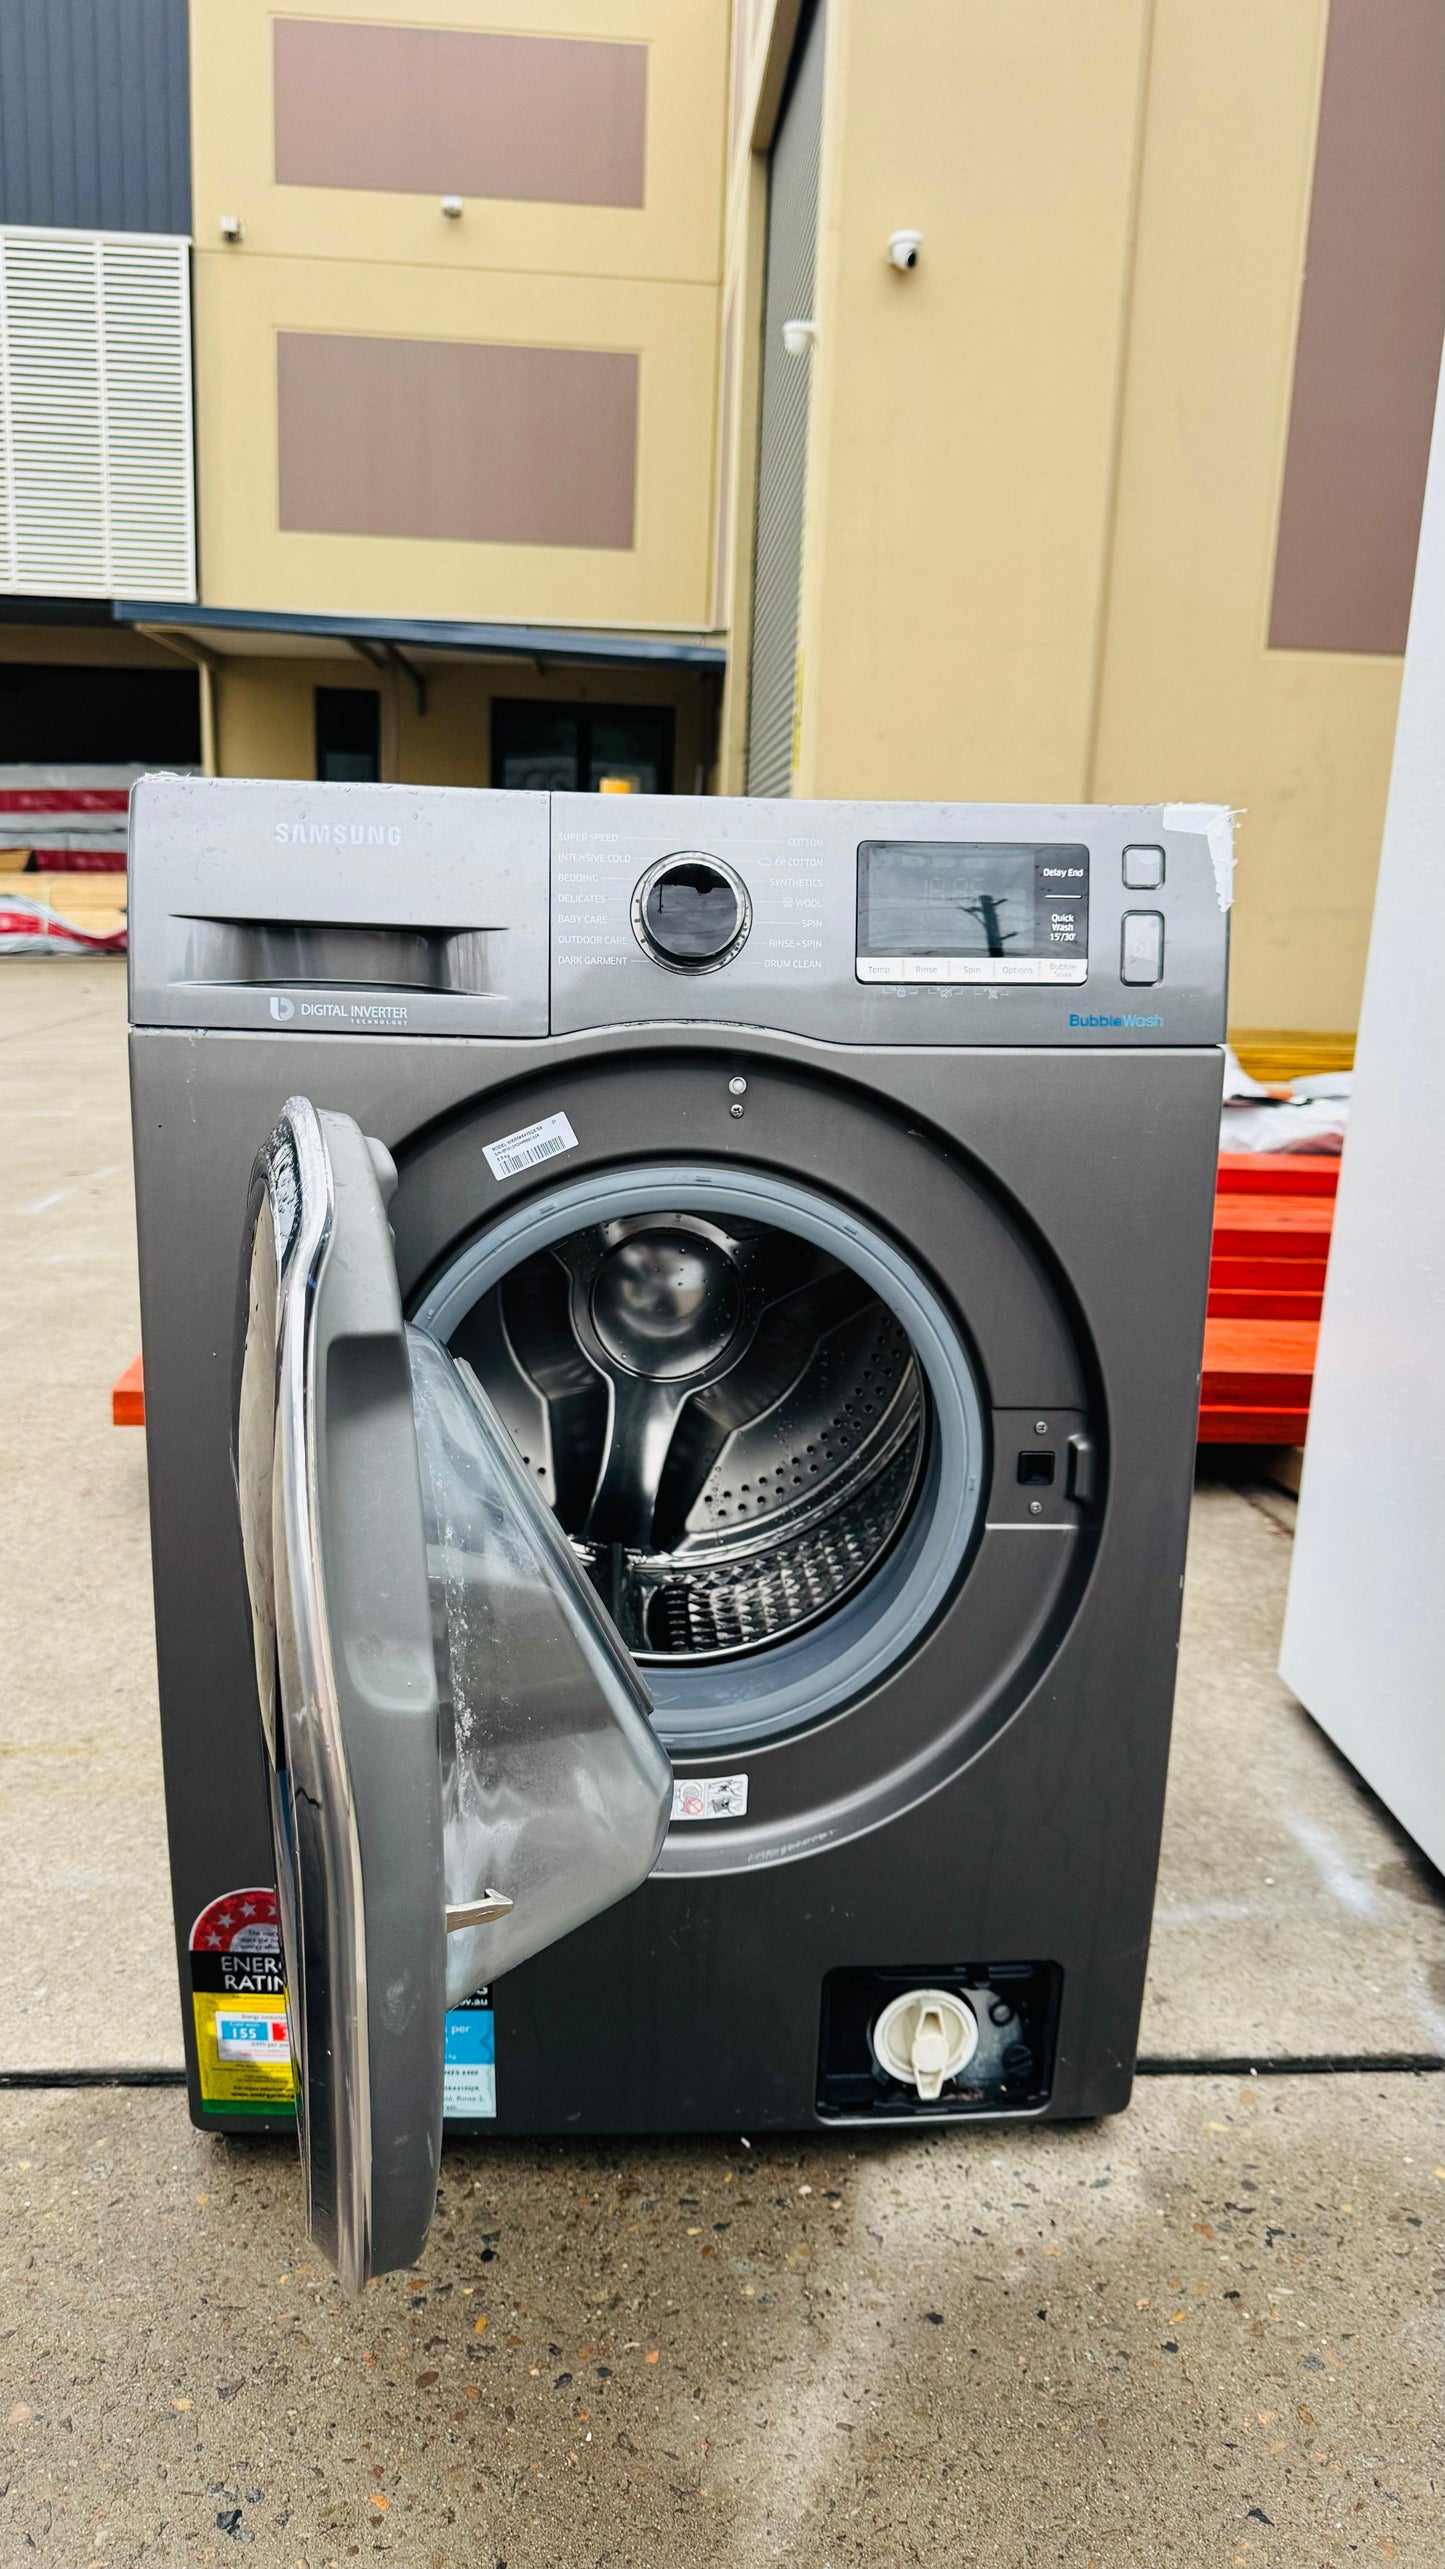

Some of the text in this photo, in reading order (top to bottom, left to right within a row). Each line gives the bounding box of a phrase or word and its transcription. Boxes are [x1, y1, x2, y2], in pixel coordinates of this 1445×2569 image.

[275, 823, 402, 846] SAMSUNG
[558, 832, 619, 842] SUPER SPEED
[787, 838, 824, 848] COTTON
[558, 853, 632, 863] INTENSIVE COLD
[787, 857, 824, 868] COTTON
[558, 873, 599, 883] BEDDING
[1043, 868, 1084, 878] Delay End
[769, 877, 824, 888] SYNTHETICS
[558, 893, 606, 904] DELICATES
[795, 898, 823, 908] WOOL
[558, 914, 608, 925] BABY CARE
[1051, 913, 1075, 923] Quick
[801, 919, 823, 928] SPIN
[1051, 923, 1074, 932] Wash
[558, 935, 629, 946] OUTDOOR CARE
[558, 955, 629, 966] DARK GARMENT
[764, 959, 822, 969] DRUM CLEAN
[915, 965, 938, 974] Rinse
[963, 966, 982, 976] Spin
[1002, 966, 1033, 975] Options
[1049, 962, 1077, 971] Bubble
[301, 1003, 408, 1019] DIGITAL INVERTER
[351, 1018, 408, 1026] TECHNOLOGY
[220, 1955, 281, 1974] ENER
[231, 2027, 257, 2039] 155
[450, 2025, 471, 2035] per
